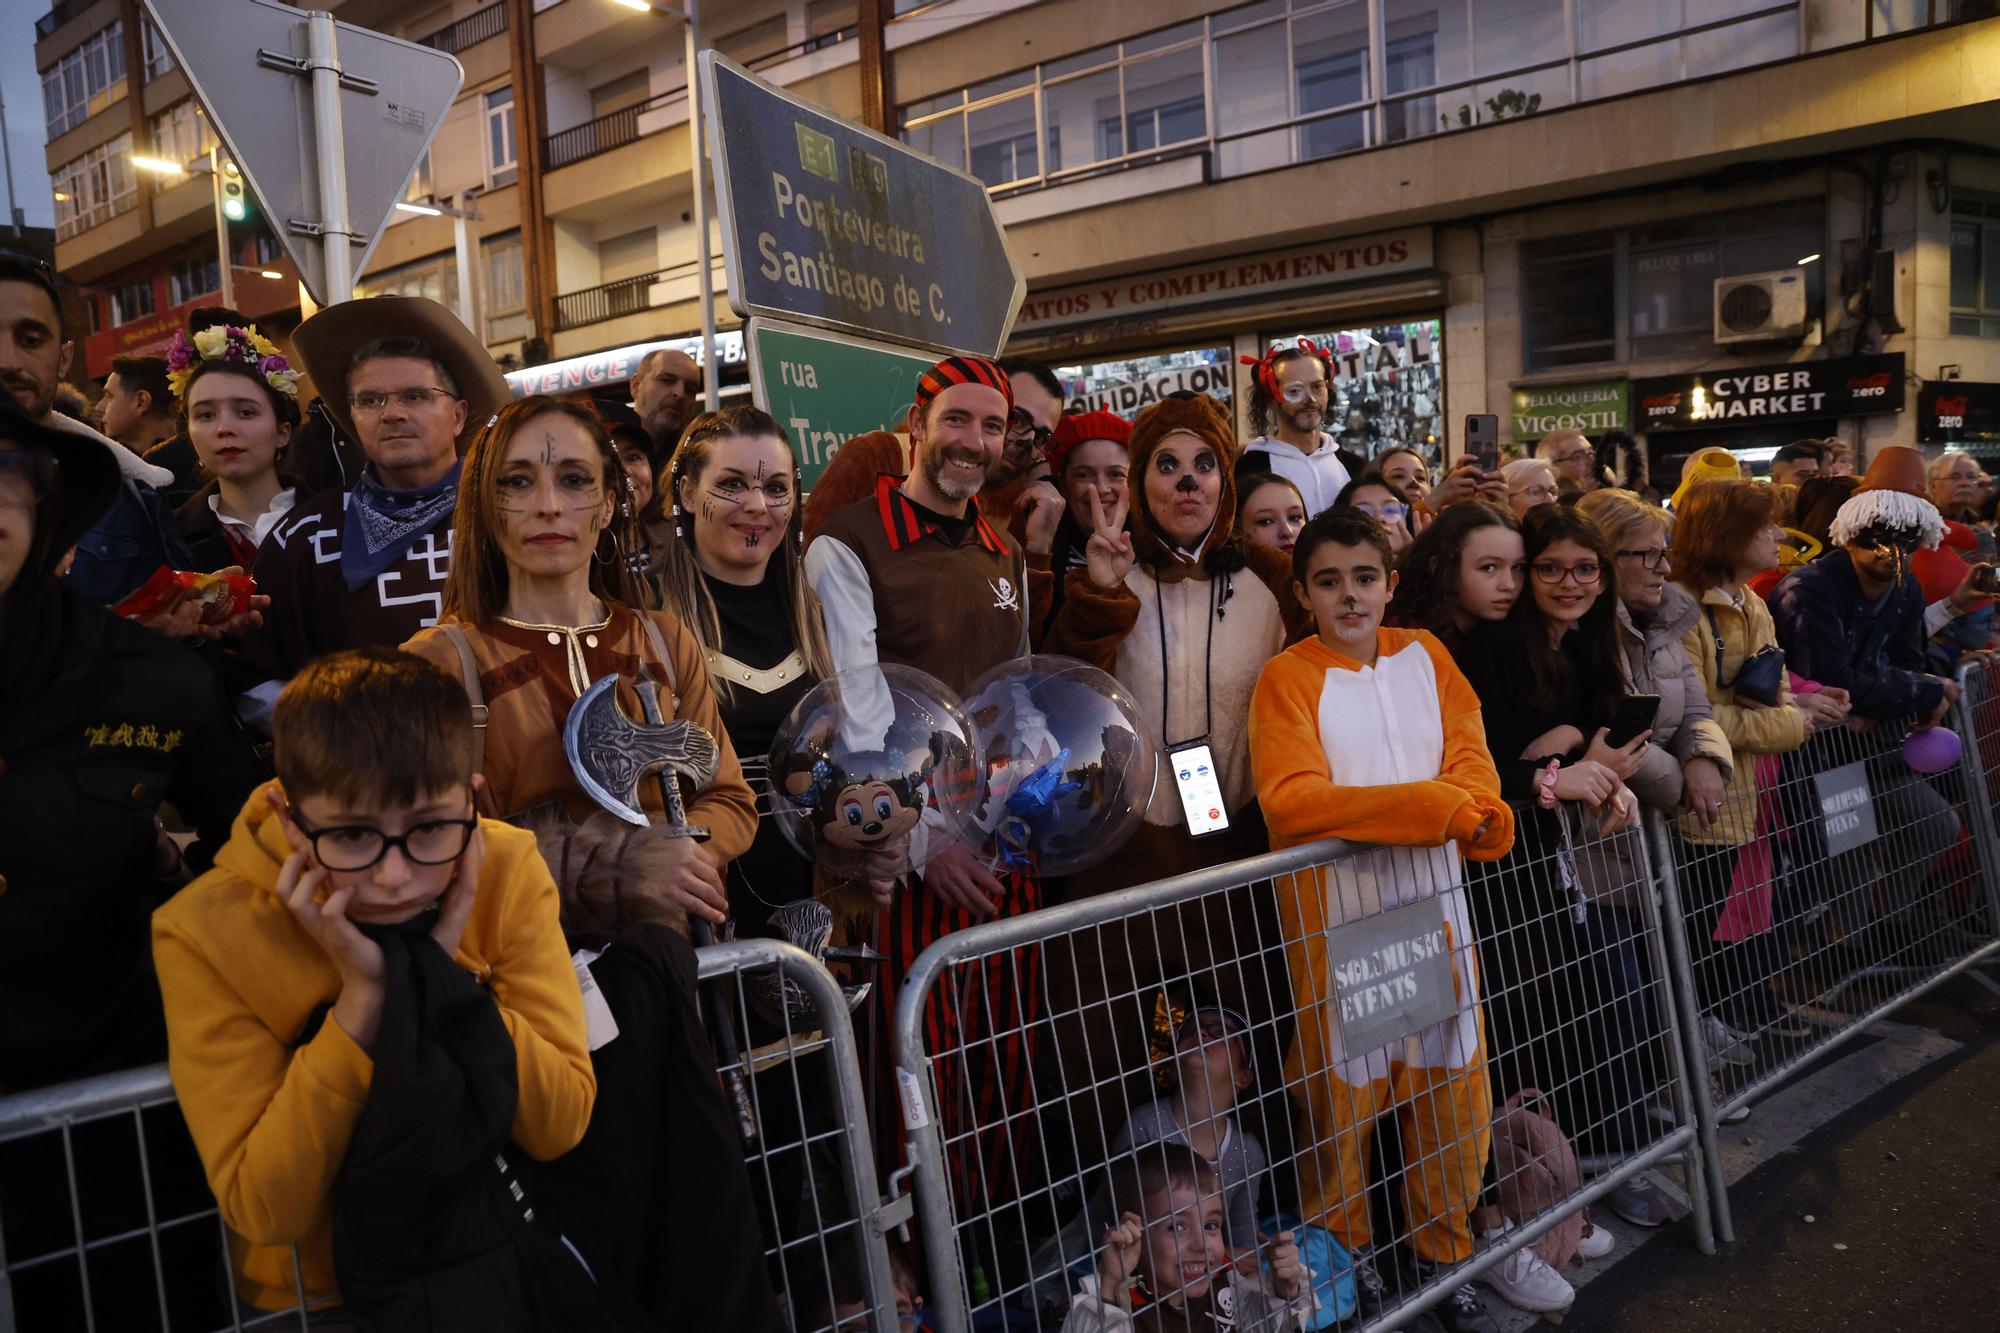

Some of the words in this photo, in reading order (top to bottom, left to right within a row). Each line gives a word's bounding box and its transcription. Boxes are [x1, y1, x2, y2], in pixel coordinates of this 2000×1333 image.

[758, 231, 885, 312] Santiago
[893, 274, 921, 317] de
[928, 282, 952, 324] C.
[1020, 293, 1091, 322] ATOS
[1101, 287, 1120, 310] Y
[1128, 239, 1409, 304] COMPLEMENTOS
[521, 358, 629, 396] VENCE
[780, 360, 818, 390] rua
[1712, 370, 1812, 397] CYBER
[1700, 392, 1826, 420] MARKET
[1852, 385, 1886, 399] zero
[1517, 411, 1625, 434] VIGOSTIL
[1647, 404, 1677, 417] zero
[1938, 414, 1963, 428] zero
[1341, 971, 1417, 1024] EVENTS
